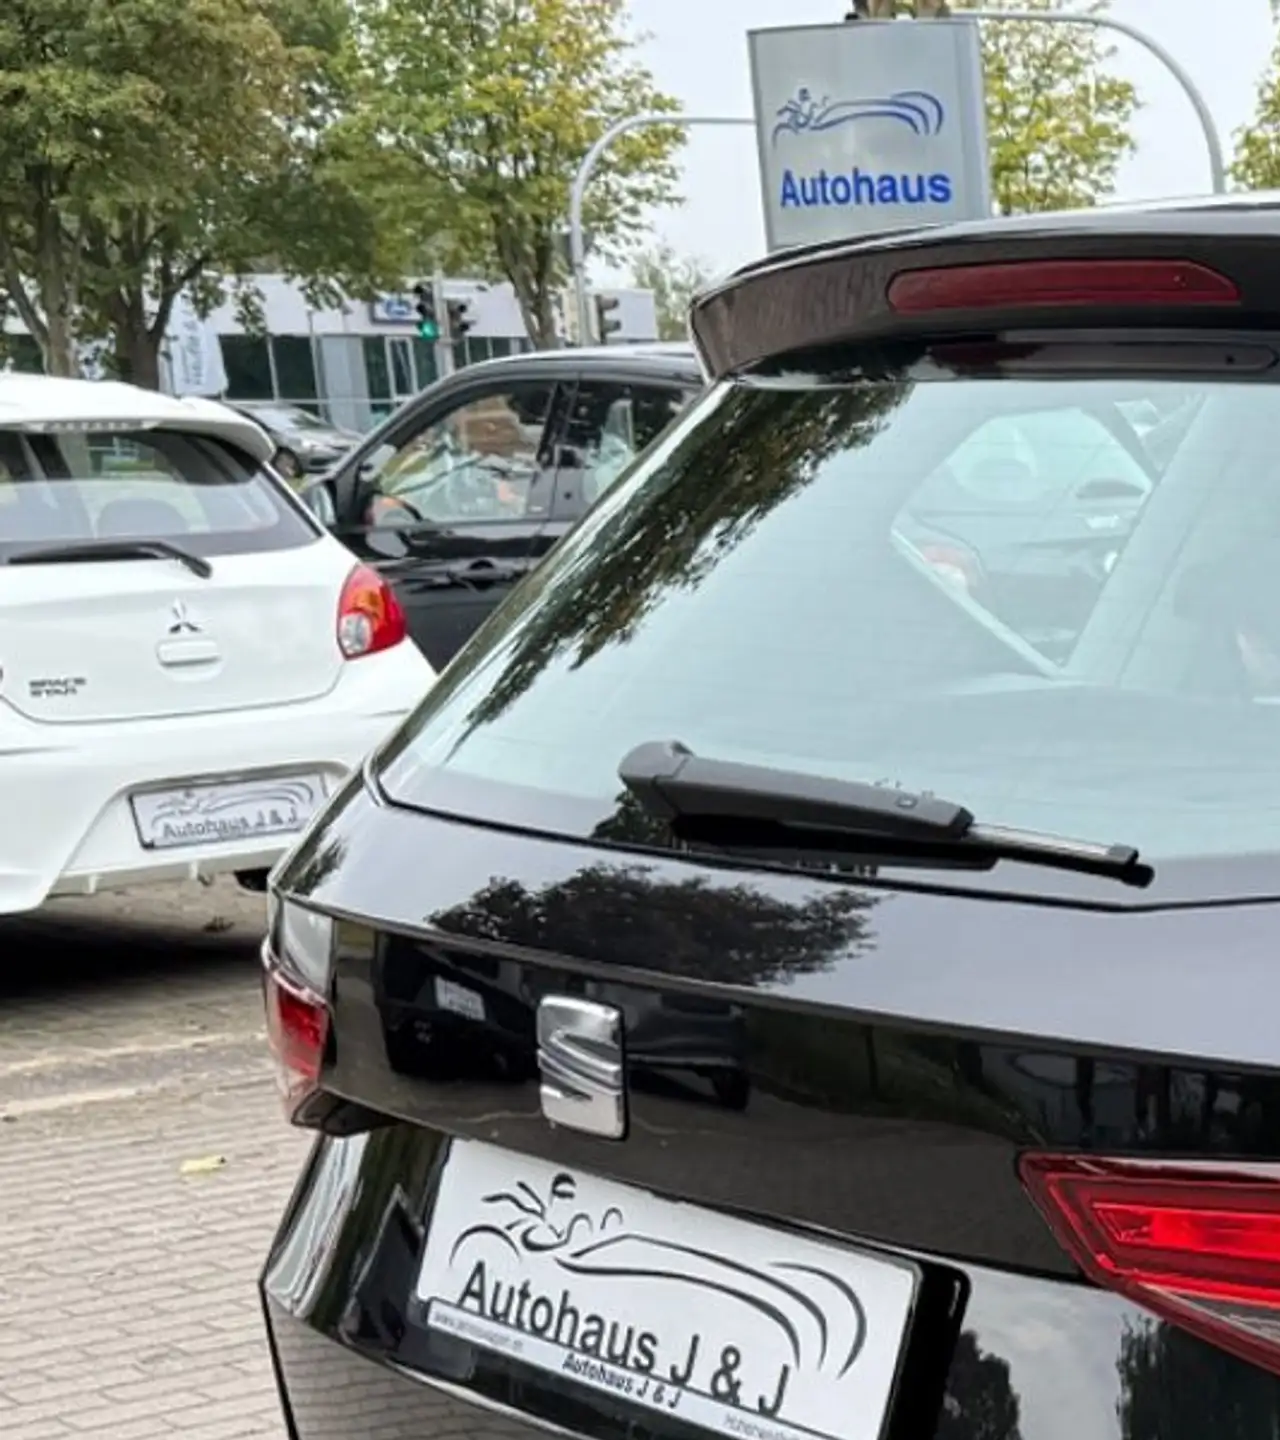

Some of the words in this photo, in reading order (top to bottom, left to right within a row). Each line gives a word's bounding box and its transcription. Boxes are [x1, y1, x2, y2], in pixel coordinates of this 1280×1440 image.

[780, 167, 952, 208] Autohaus
[163, 816, 250, 839] Autohaus
[457, 1259, 658, 1374] Autohaus
[669, 1333, 700, 1386] J
[711, 1345, 742, 1406] &
[758, 1364, 790, 1418] J
[562, 1353, 633, 1394] Autohaus
[636, 1379, 650, 1398] J
[667, 1389, 683, 1409] J
